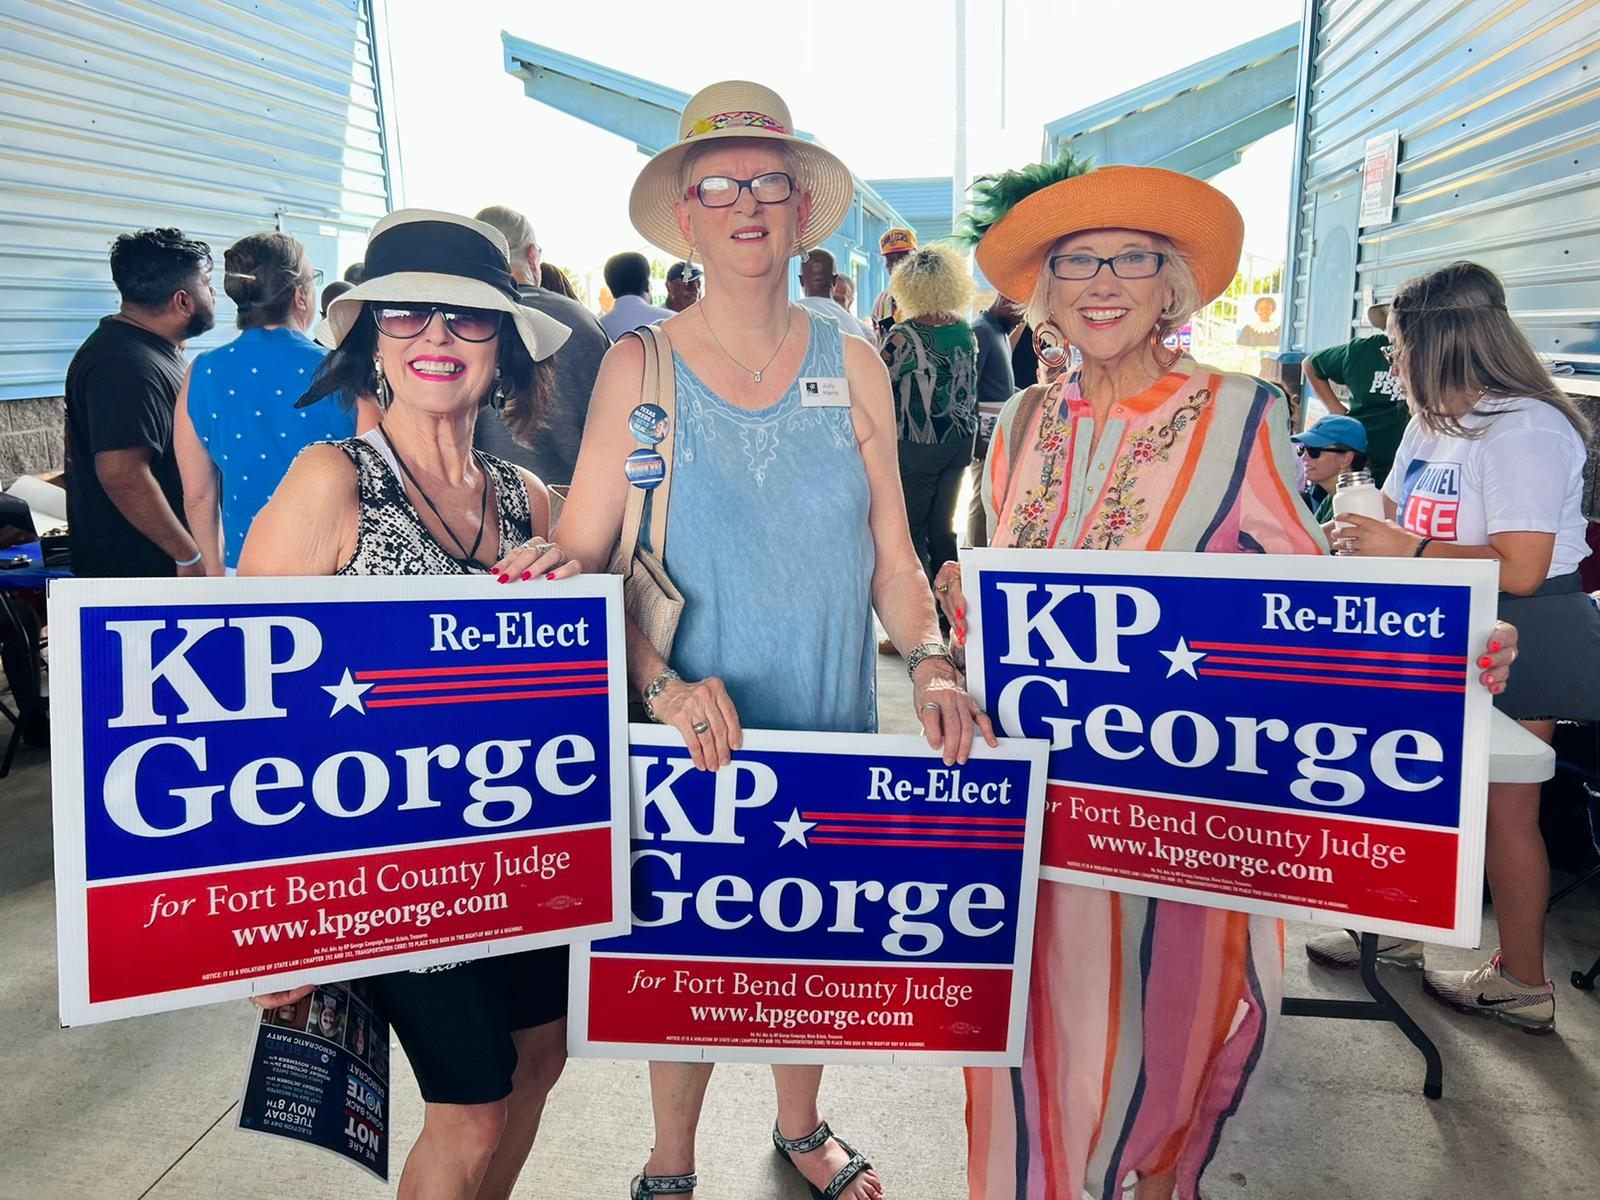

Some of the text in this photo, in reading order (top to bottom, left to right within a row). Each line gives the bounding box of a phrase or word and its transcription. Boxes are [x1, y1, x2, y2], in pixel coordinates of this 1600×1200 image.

[1404, 497, 1458, 538] LEE
[429, 611, 590, 652] Re-Elect
[996, 582, 1161, 674] KP
[1262, 593, 1446, 639] Re-Elect
[105, 615, 323, 729] KP
[998, 675, 1444, 807] George
[103, 734, 597, 838] George
[629, 755, 778, 844] KP
[867, 766, 1012, 805] Re-Elect
[1069, 796, 1406, 869] Fort Bend County Judge
[1088, 834, 1334, 884] www.kpgeorge.com
[144, 846, 570, 928] for Fort Bend County Judge
[631, 849, 1006, 957] George
[231, 891, 509, 947] www.kpgeorge.com
[240, 965, 266, 975] VIOLATION
[273, 961, 289, 969] STATE
[628, 969, 973, 1008] for Fort Bend County Judge
[690, 1001, 914, 1030] www.kpgeorge.com
[266, 1032, 336, 1057] DEMOCRATIC PARTY
[265, 1108, 313, 1128] TUESDAY
[266, 1099, 316, 1118] NOV 8TH
[345, 1097, 365, 1116] BACK
[346, 1079, 382, 1119] VOTE
[271, 1120, 283, 1128] DAY
[344, 1117, 379, 1153] NOT
[348, 1139, 363, 1153] ARE
